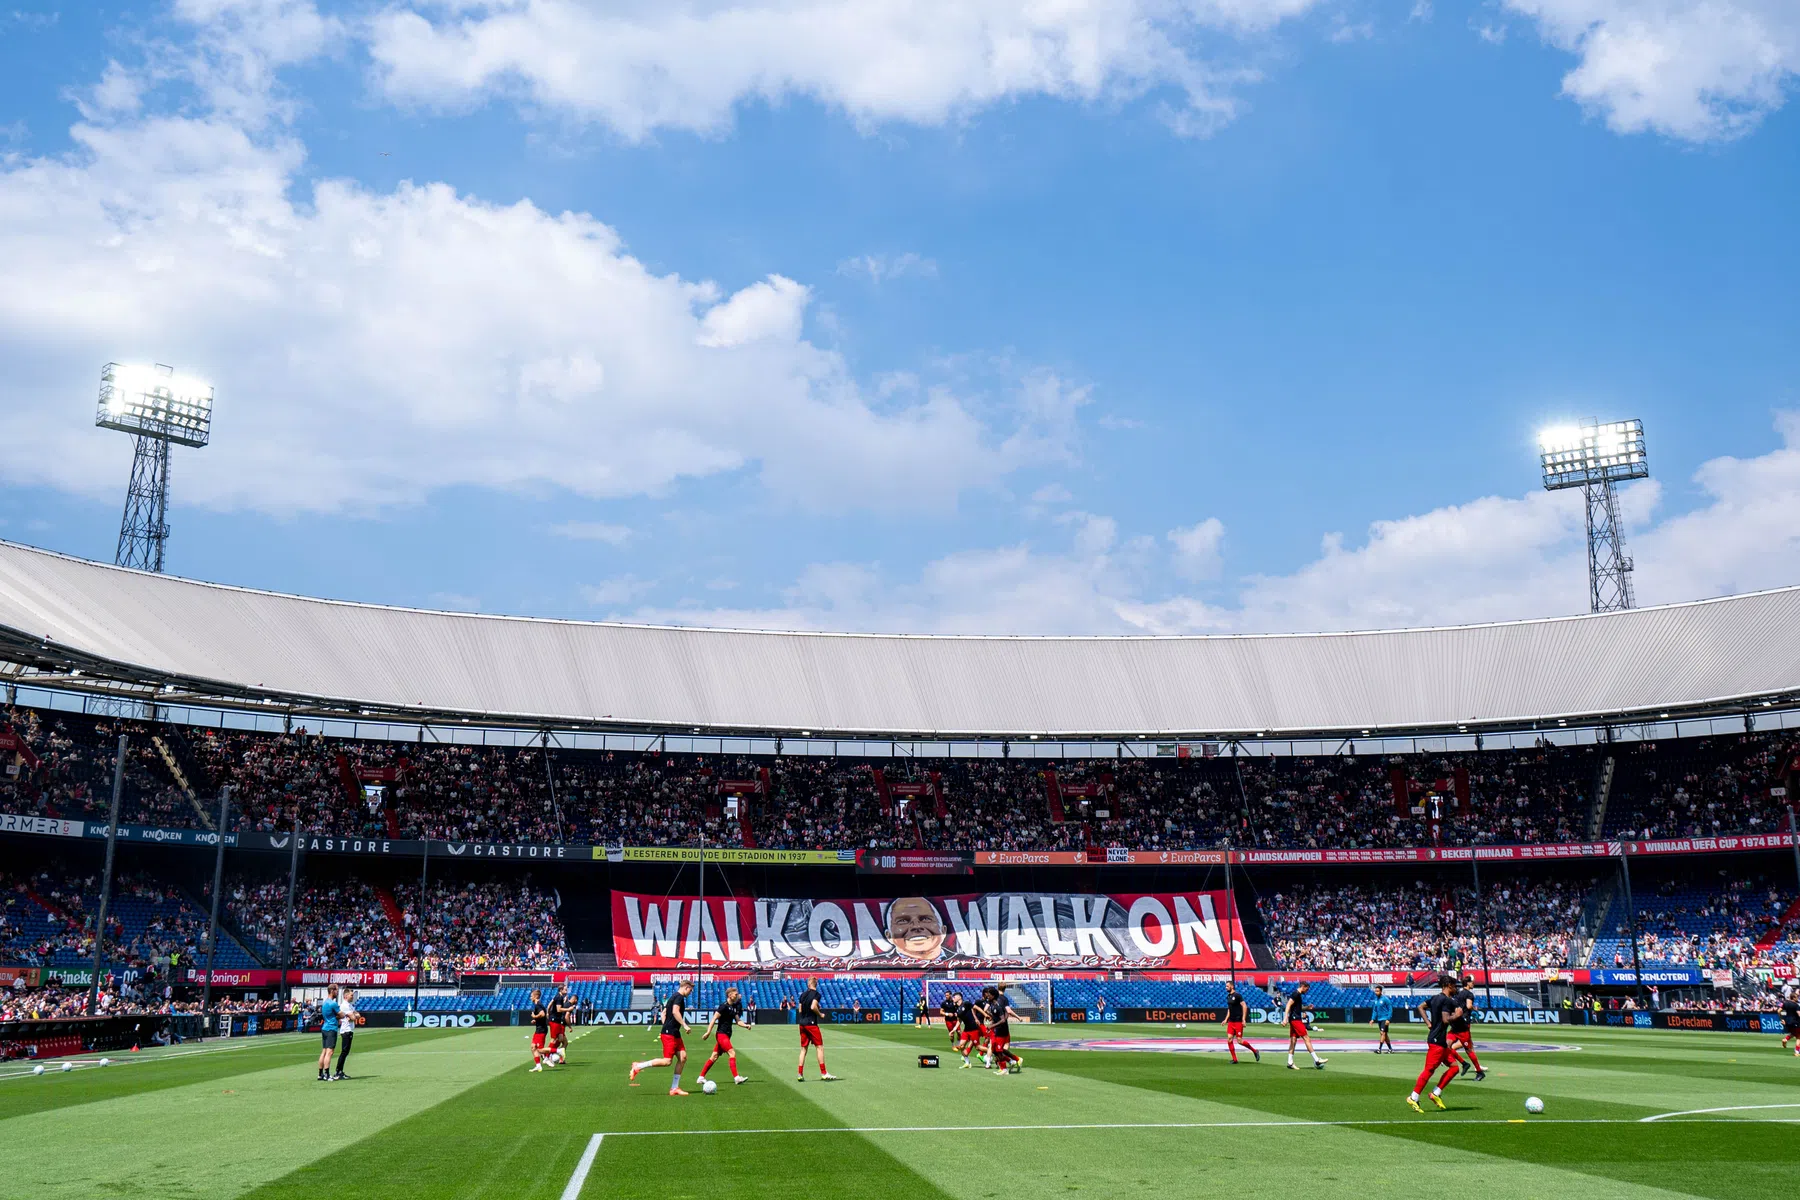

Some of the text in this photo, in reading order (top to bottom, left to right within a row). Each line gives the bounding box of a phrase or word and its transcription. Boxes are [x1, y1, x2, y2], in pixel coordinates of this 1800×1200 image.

[90, 825, 129, 838] KNAEN
[142, 828, 182, 842] KNAKEN
[297, 838, 390, 853] CASTORE
[1645, 841, 1691, 852] WINNAAR
[1692, 839, 1716, 850] UEFA
[1719, 838, 1738, 849] CUP
[1741, 836, 1765, 847] 1974
[1767, 836, 1780, 846] EN
[474, 845, 565, 857] CASTORE
[634, 850, 678, 858] EESTEREN
[682, 850, 719, 859] BOUWDE
[722, 851, 736, 860] DIT
[738, 852, 775, 861] STADION
[777, 852, 786, 861] IN
[788, 852, 807, 861] 1937
[1249, 852, 1322, 861] LANDSKAMPIOEN
[999, 854, 1049, 863] EuroParcs
[1171, 853, 1221, 862] EuroParcs
[623, 896, 802, 962] WALK
[808, 901, 896, 958] ON
[943, 896, 1127, 960] WALK
[1026, 955, 1078, 967] Arne
[373, 973, 388, 984] 1970
[403, 1011, 493, 1028] Deno XL
[865, 1012, 881, 1021] en
[883, 1010, 914, 1021] Sales
[1070, 1012, 1085, 1021] en
[1088, 1010, 1117, 1021] Saes
[1145, 1010, 1216, 1021] LED-reclame
[1625, 1015, 1634, 1025] en
[1634, 1014, 1652, 1026] Sales
[1667, 1015, 1713, 1028] LED-reclame
[1725, 1017, 1784, 1031] Sport en Sales
